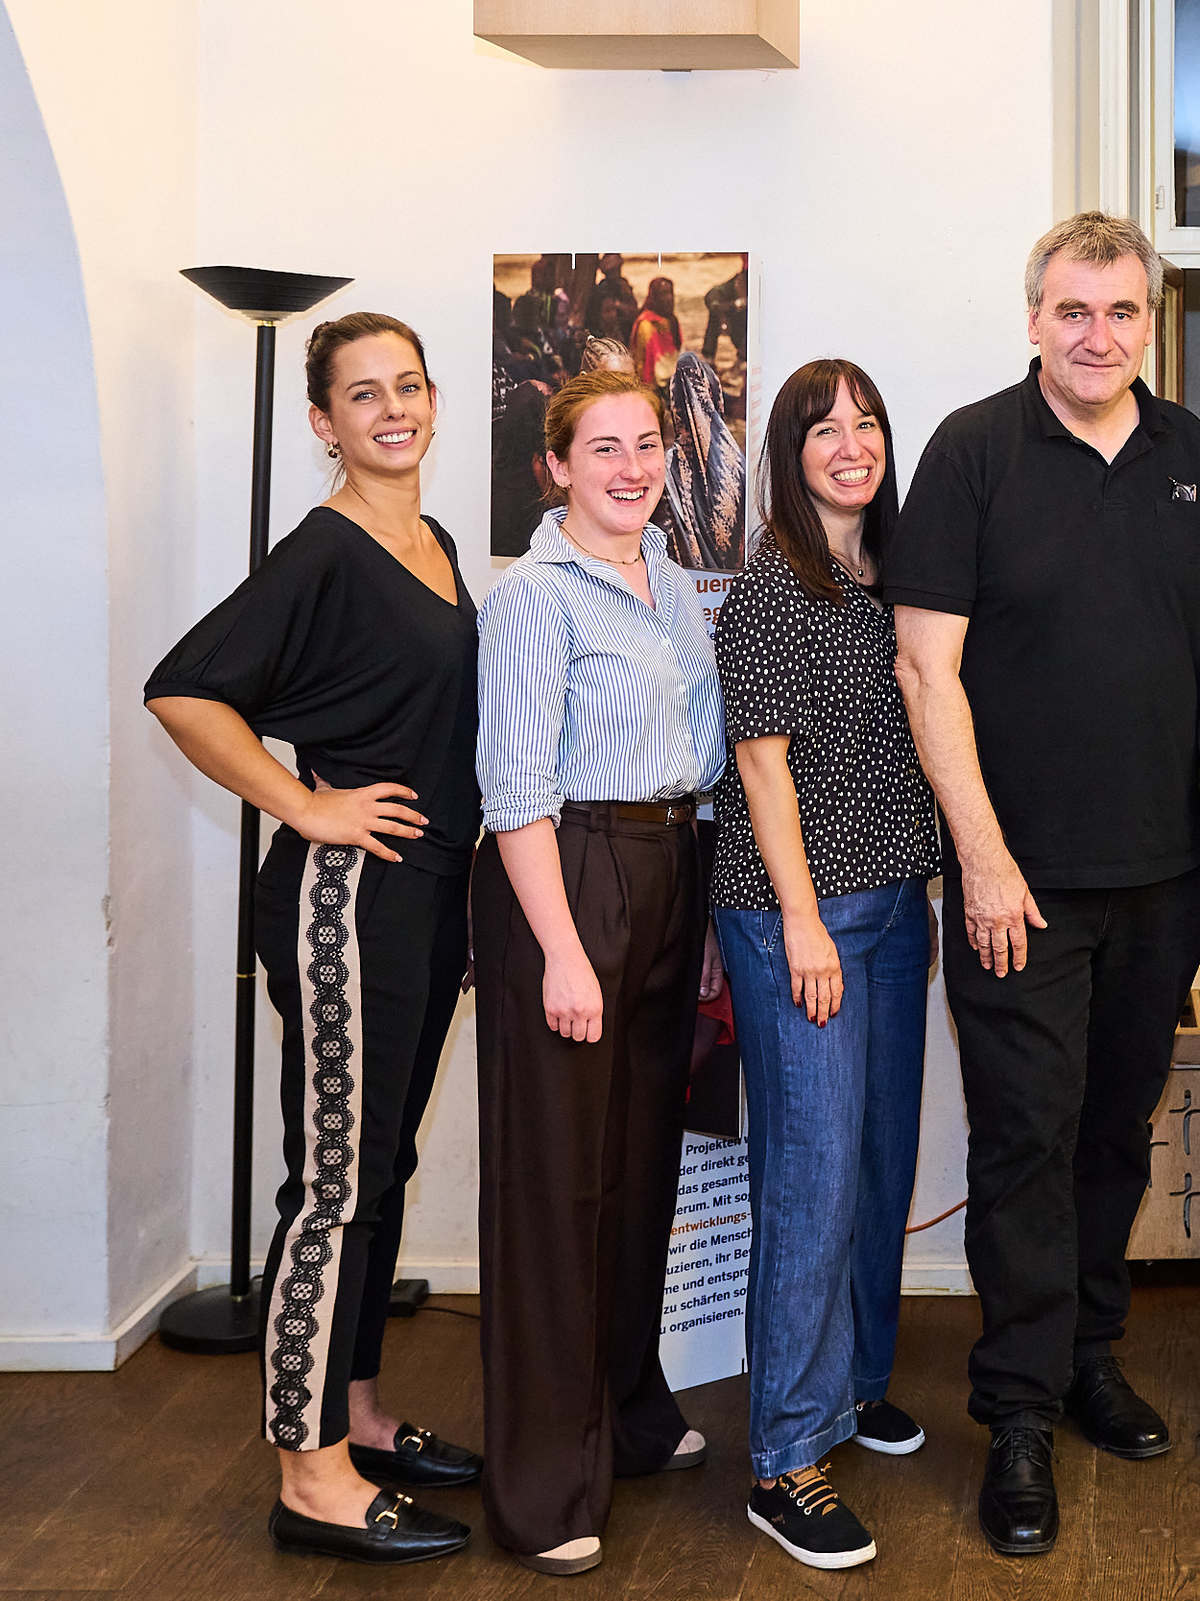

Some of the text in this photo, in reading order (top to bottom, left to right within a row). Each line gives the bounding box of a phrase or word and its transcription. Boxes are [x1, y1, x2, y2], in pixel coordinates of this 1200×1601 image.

[701, 1155, 735, 1172] direkt
[678, 1173, 751, 1195] das gesamte
[713, 1194, 731, 1207] Mit
[735, 1192, 751, 1203] so
[671, 1212, 751, 1236] entwicklungs-
[669, 1243, 686, 1255] wir
[690, 1238, 707, 1251] die
[667, 1248, 751, 1275] uzieren, ihr Be
[683, 1276, 704, 1291] und
[663, 1287, 746, 1315] zu schärfen so
[669, 1307, 744, 1332] organisieren.
